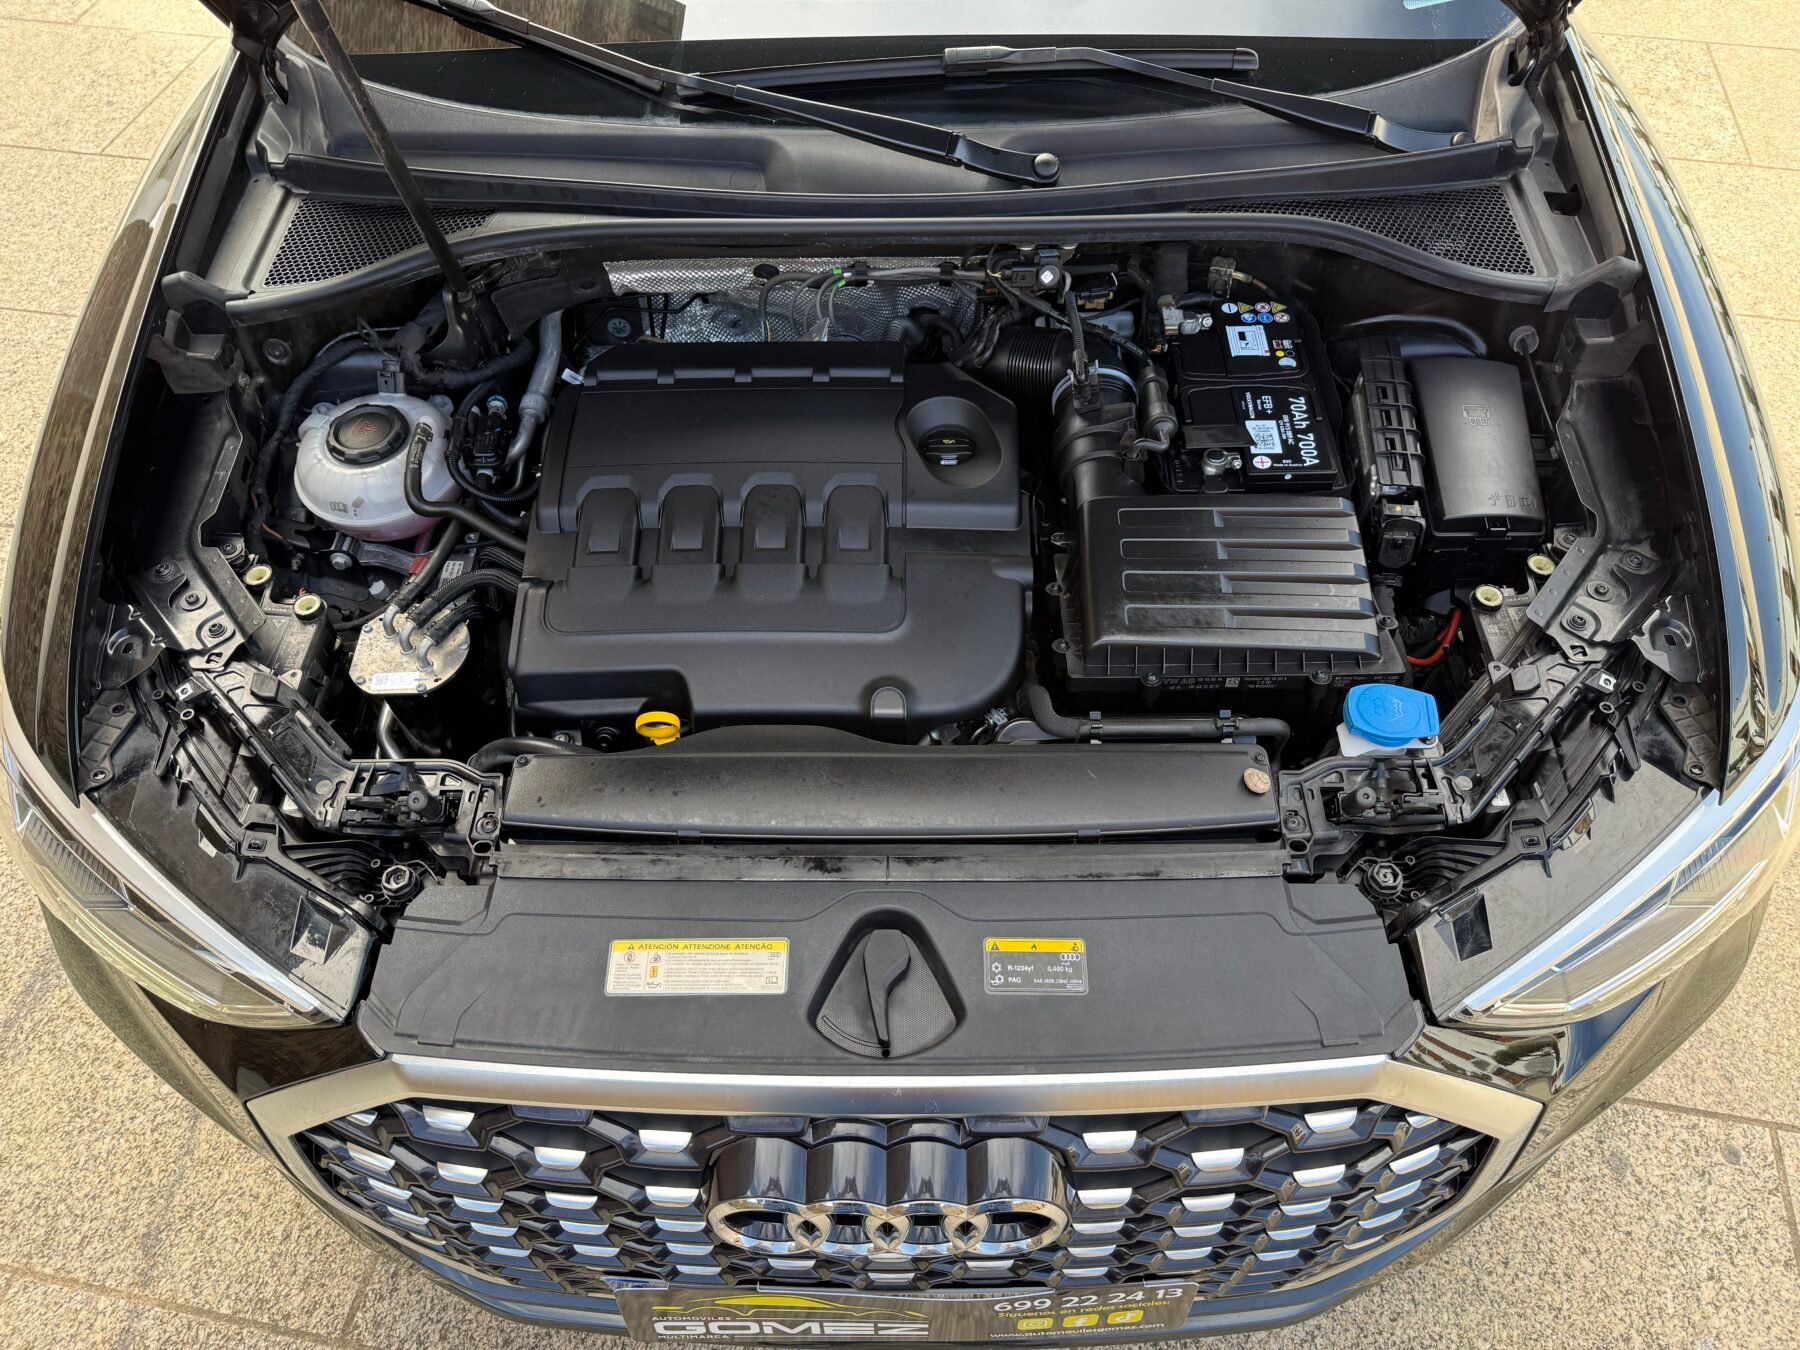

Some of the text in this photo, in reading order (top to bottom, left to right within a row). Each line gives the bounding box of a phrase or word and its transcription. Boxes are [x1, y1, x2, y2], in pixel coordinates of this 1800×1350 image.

[1288, 397, 1320, 466] 70Ah 700A
[638, 942, 679, 950] ATENCIÓN
[734, 942, 773, 950] ATENÇÃO
[993, 1288, 1184, 1312] 699 22 24 13
[1080, 1304, 1115, 1313] redes
[1118, 1300, 1170, 1309] sociales:
[653, 1321, 929, 1335] GOMEZ
